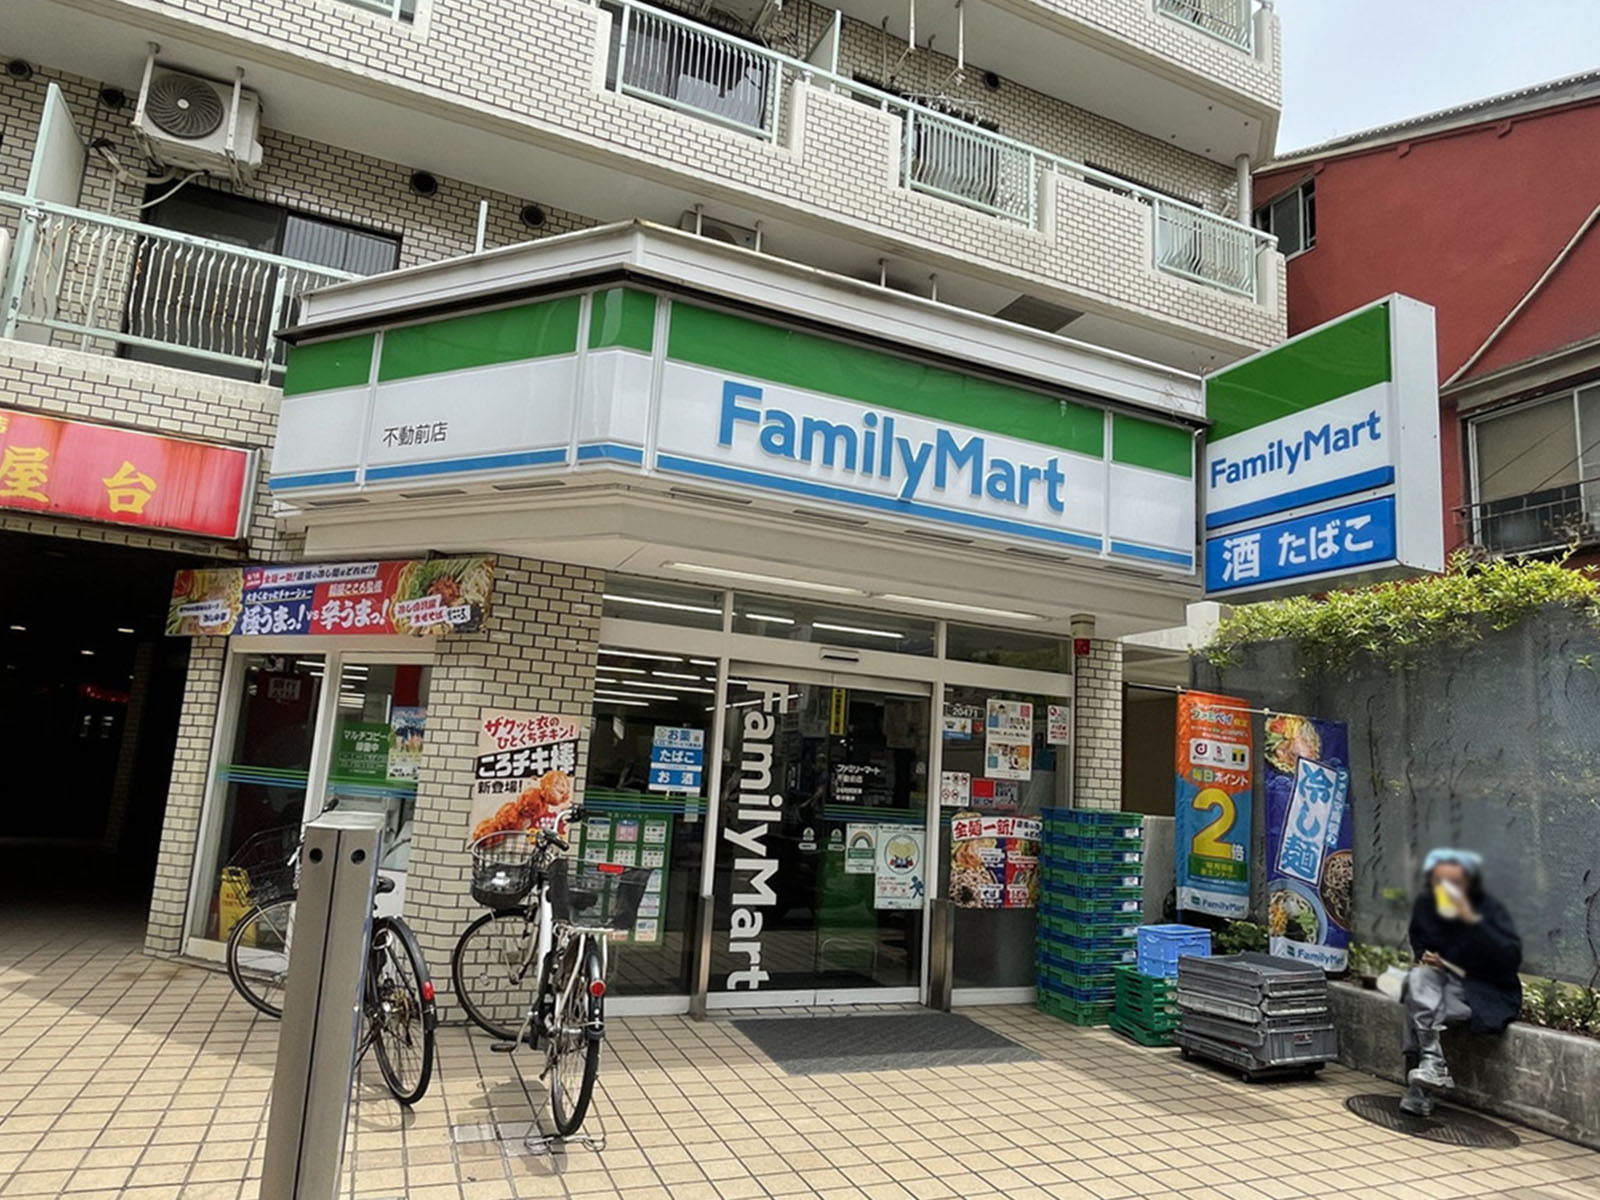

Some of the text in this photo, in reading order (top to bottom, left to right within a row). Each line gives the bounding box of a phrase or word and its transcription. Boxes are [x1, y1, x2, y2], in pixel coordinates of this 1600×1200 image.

[382, 421, 448, 447] 不動前店
[718, 380, 1065, 512] FamilyMart
[1210, 410, 1381, 489] FamilyMart
[1222, 514, 1374, 582] 酒 たばこ
[485, 715, 560, 737] ザクッと衣の
[497, 724, 574, 749] ひとくちチキン!
[479, 742, 575, 776] ころチキ棒
[660, 749, 695, 763] たばこ
[478, 780, 523, 795] 新登場!
[724, 681, 789, 990] FamilyMart
[1192, 787, 1236, 859] 2
[1280, 761, 1334, 880] 冷し麺
